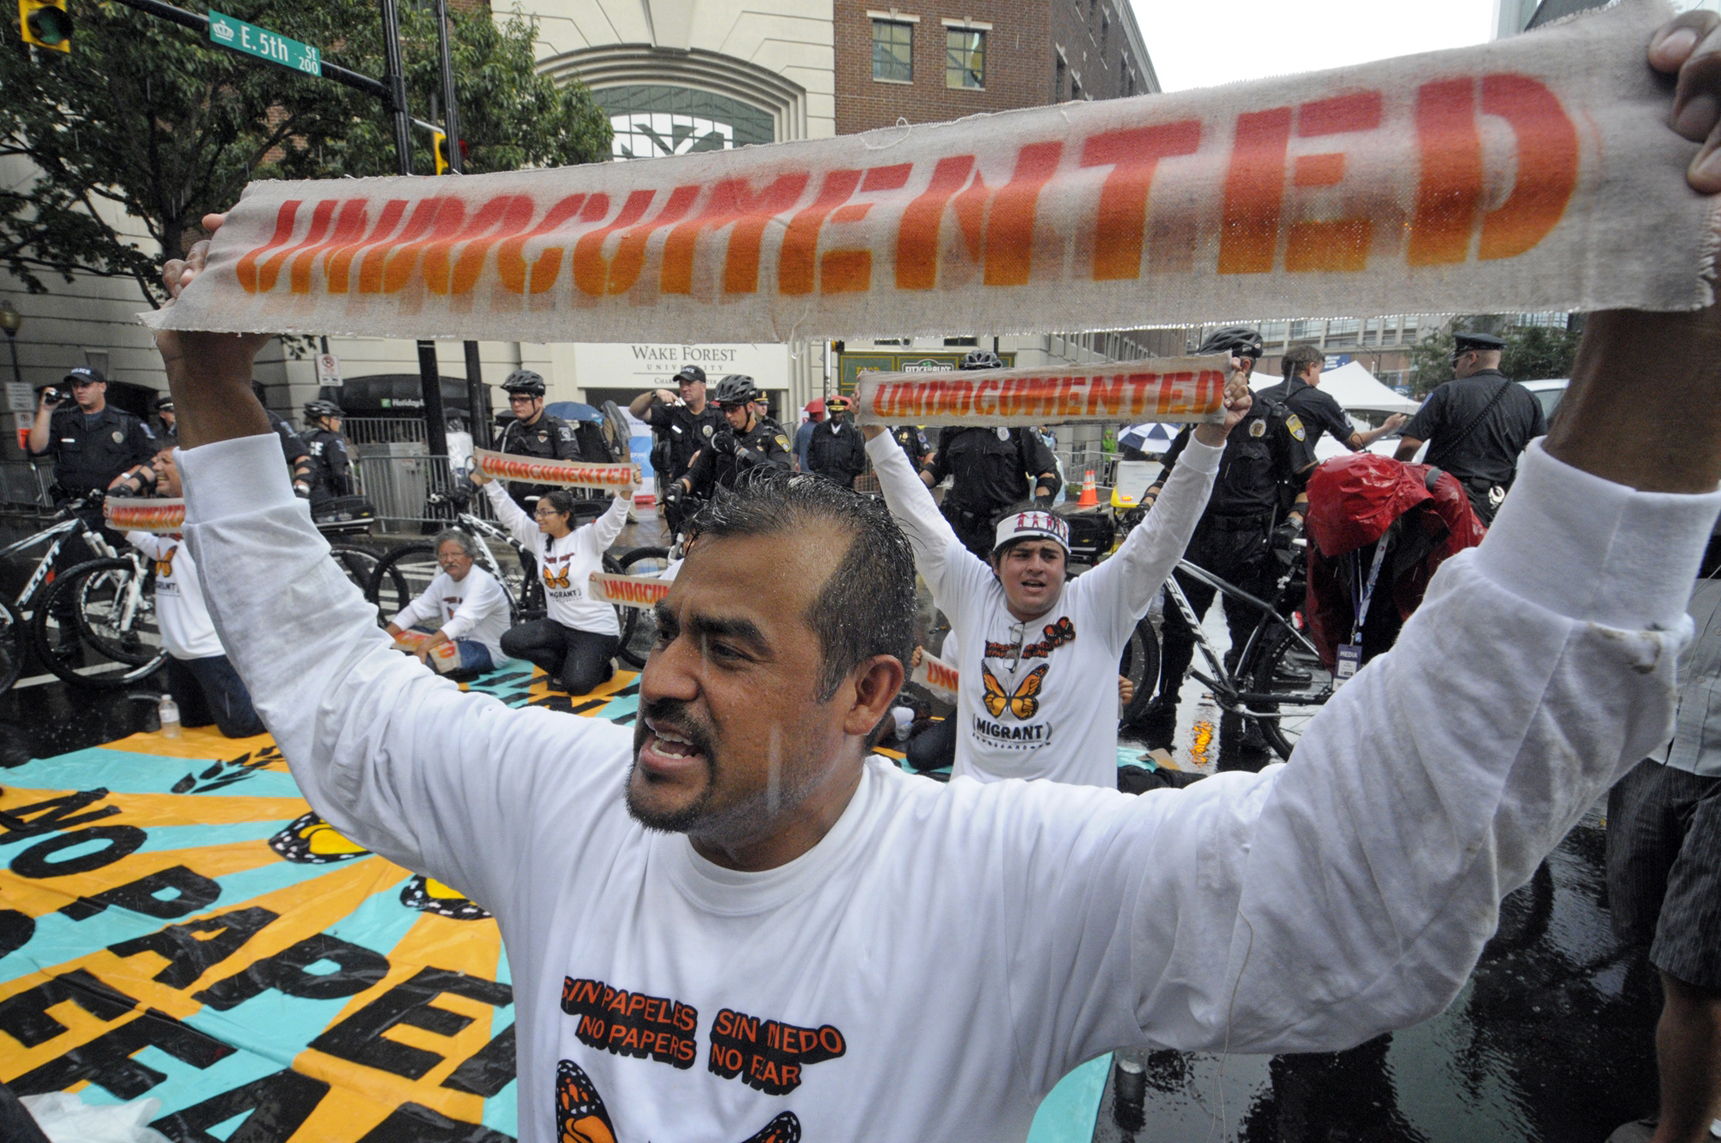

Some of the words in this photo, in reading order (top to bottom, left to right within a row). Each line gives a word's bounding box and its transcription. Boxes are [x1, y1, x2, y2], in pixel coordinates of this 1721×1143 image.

[241, 25, 257, 51] E.
[260, 33, 289, 62] 5th
[305, 45, 316, 60] St
[298, 57, 319, 74] 200
[236, 72, 1579, 297] UNDOCUMENTED
[646, 363, 724, 371] UNIVITY
[682, 347, 737, 361] FOREST
[872, 370, 1226, 418] UNDOCUMENTED
[482, 455, 631, 485] UNDOCUMENTED
[18, 540, 61, 607] SCOTT
[602, 988, 695, 1031] PAPELES
[579, 1015, 605, 1039] NO
[608, 1024, 694, 1061] PAPERS
[716, 1011, 758, 1043] SIN
[711, 1043, 743, 1071] NO
